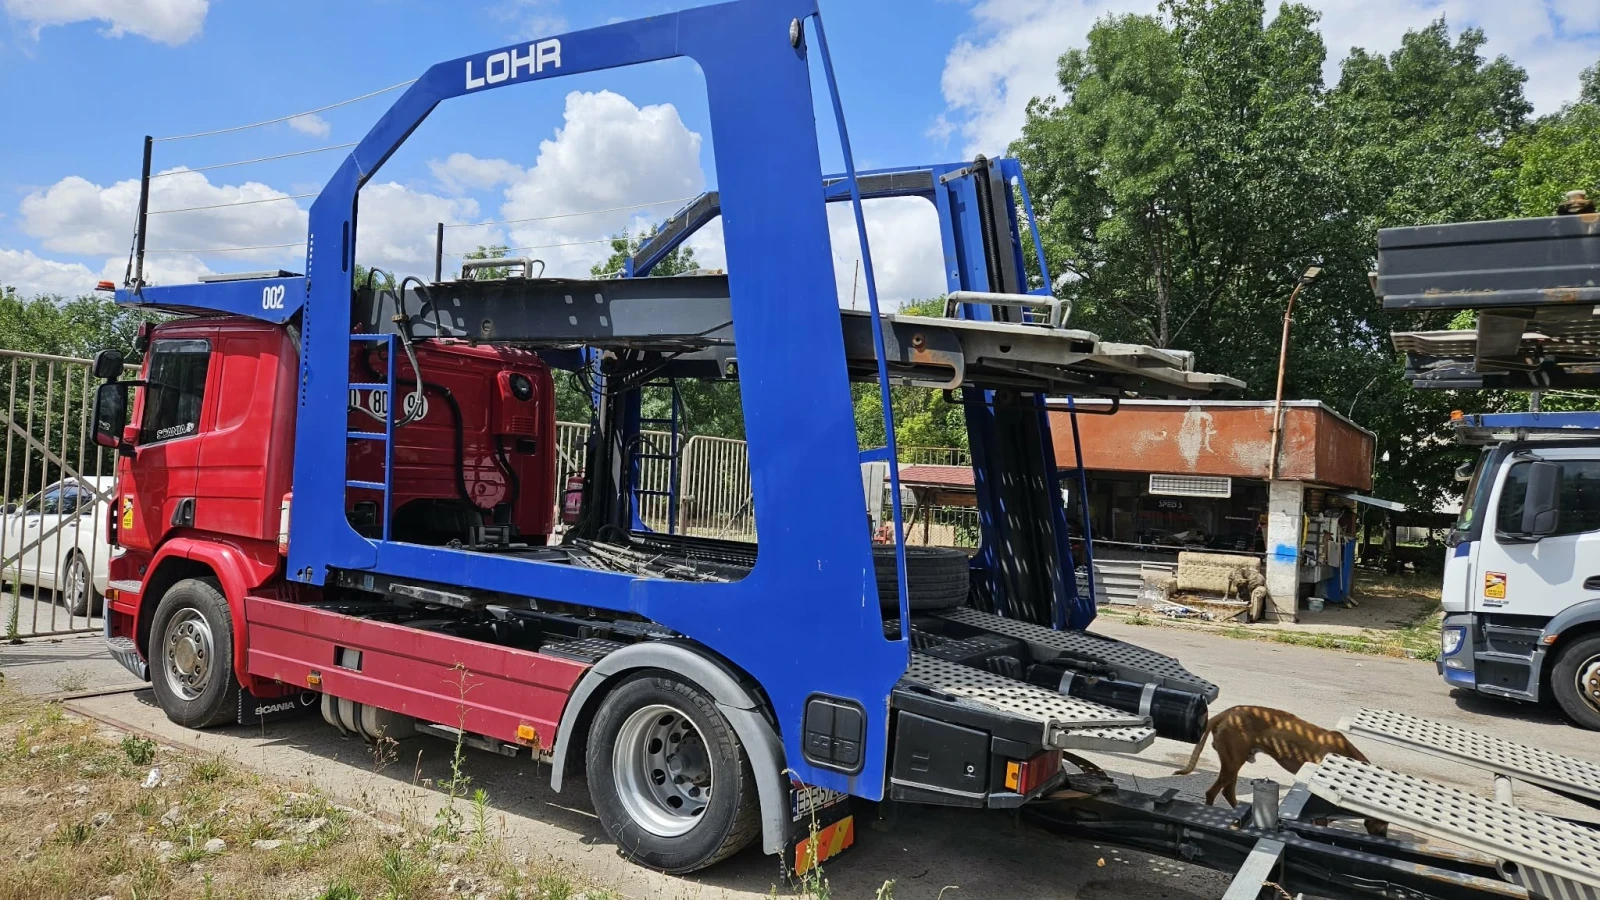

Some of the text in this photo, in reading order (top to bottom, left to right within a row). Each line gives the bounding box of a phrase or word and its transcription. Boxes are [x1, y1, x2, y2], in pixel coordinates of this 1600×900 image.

[466, 39, 561, 89] LOHR
[262, 285, 285, 309] 002
[255, 702, 295, 715] SCANIA
[674, 683, 734, 759] MICHELIN
